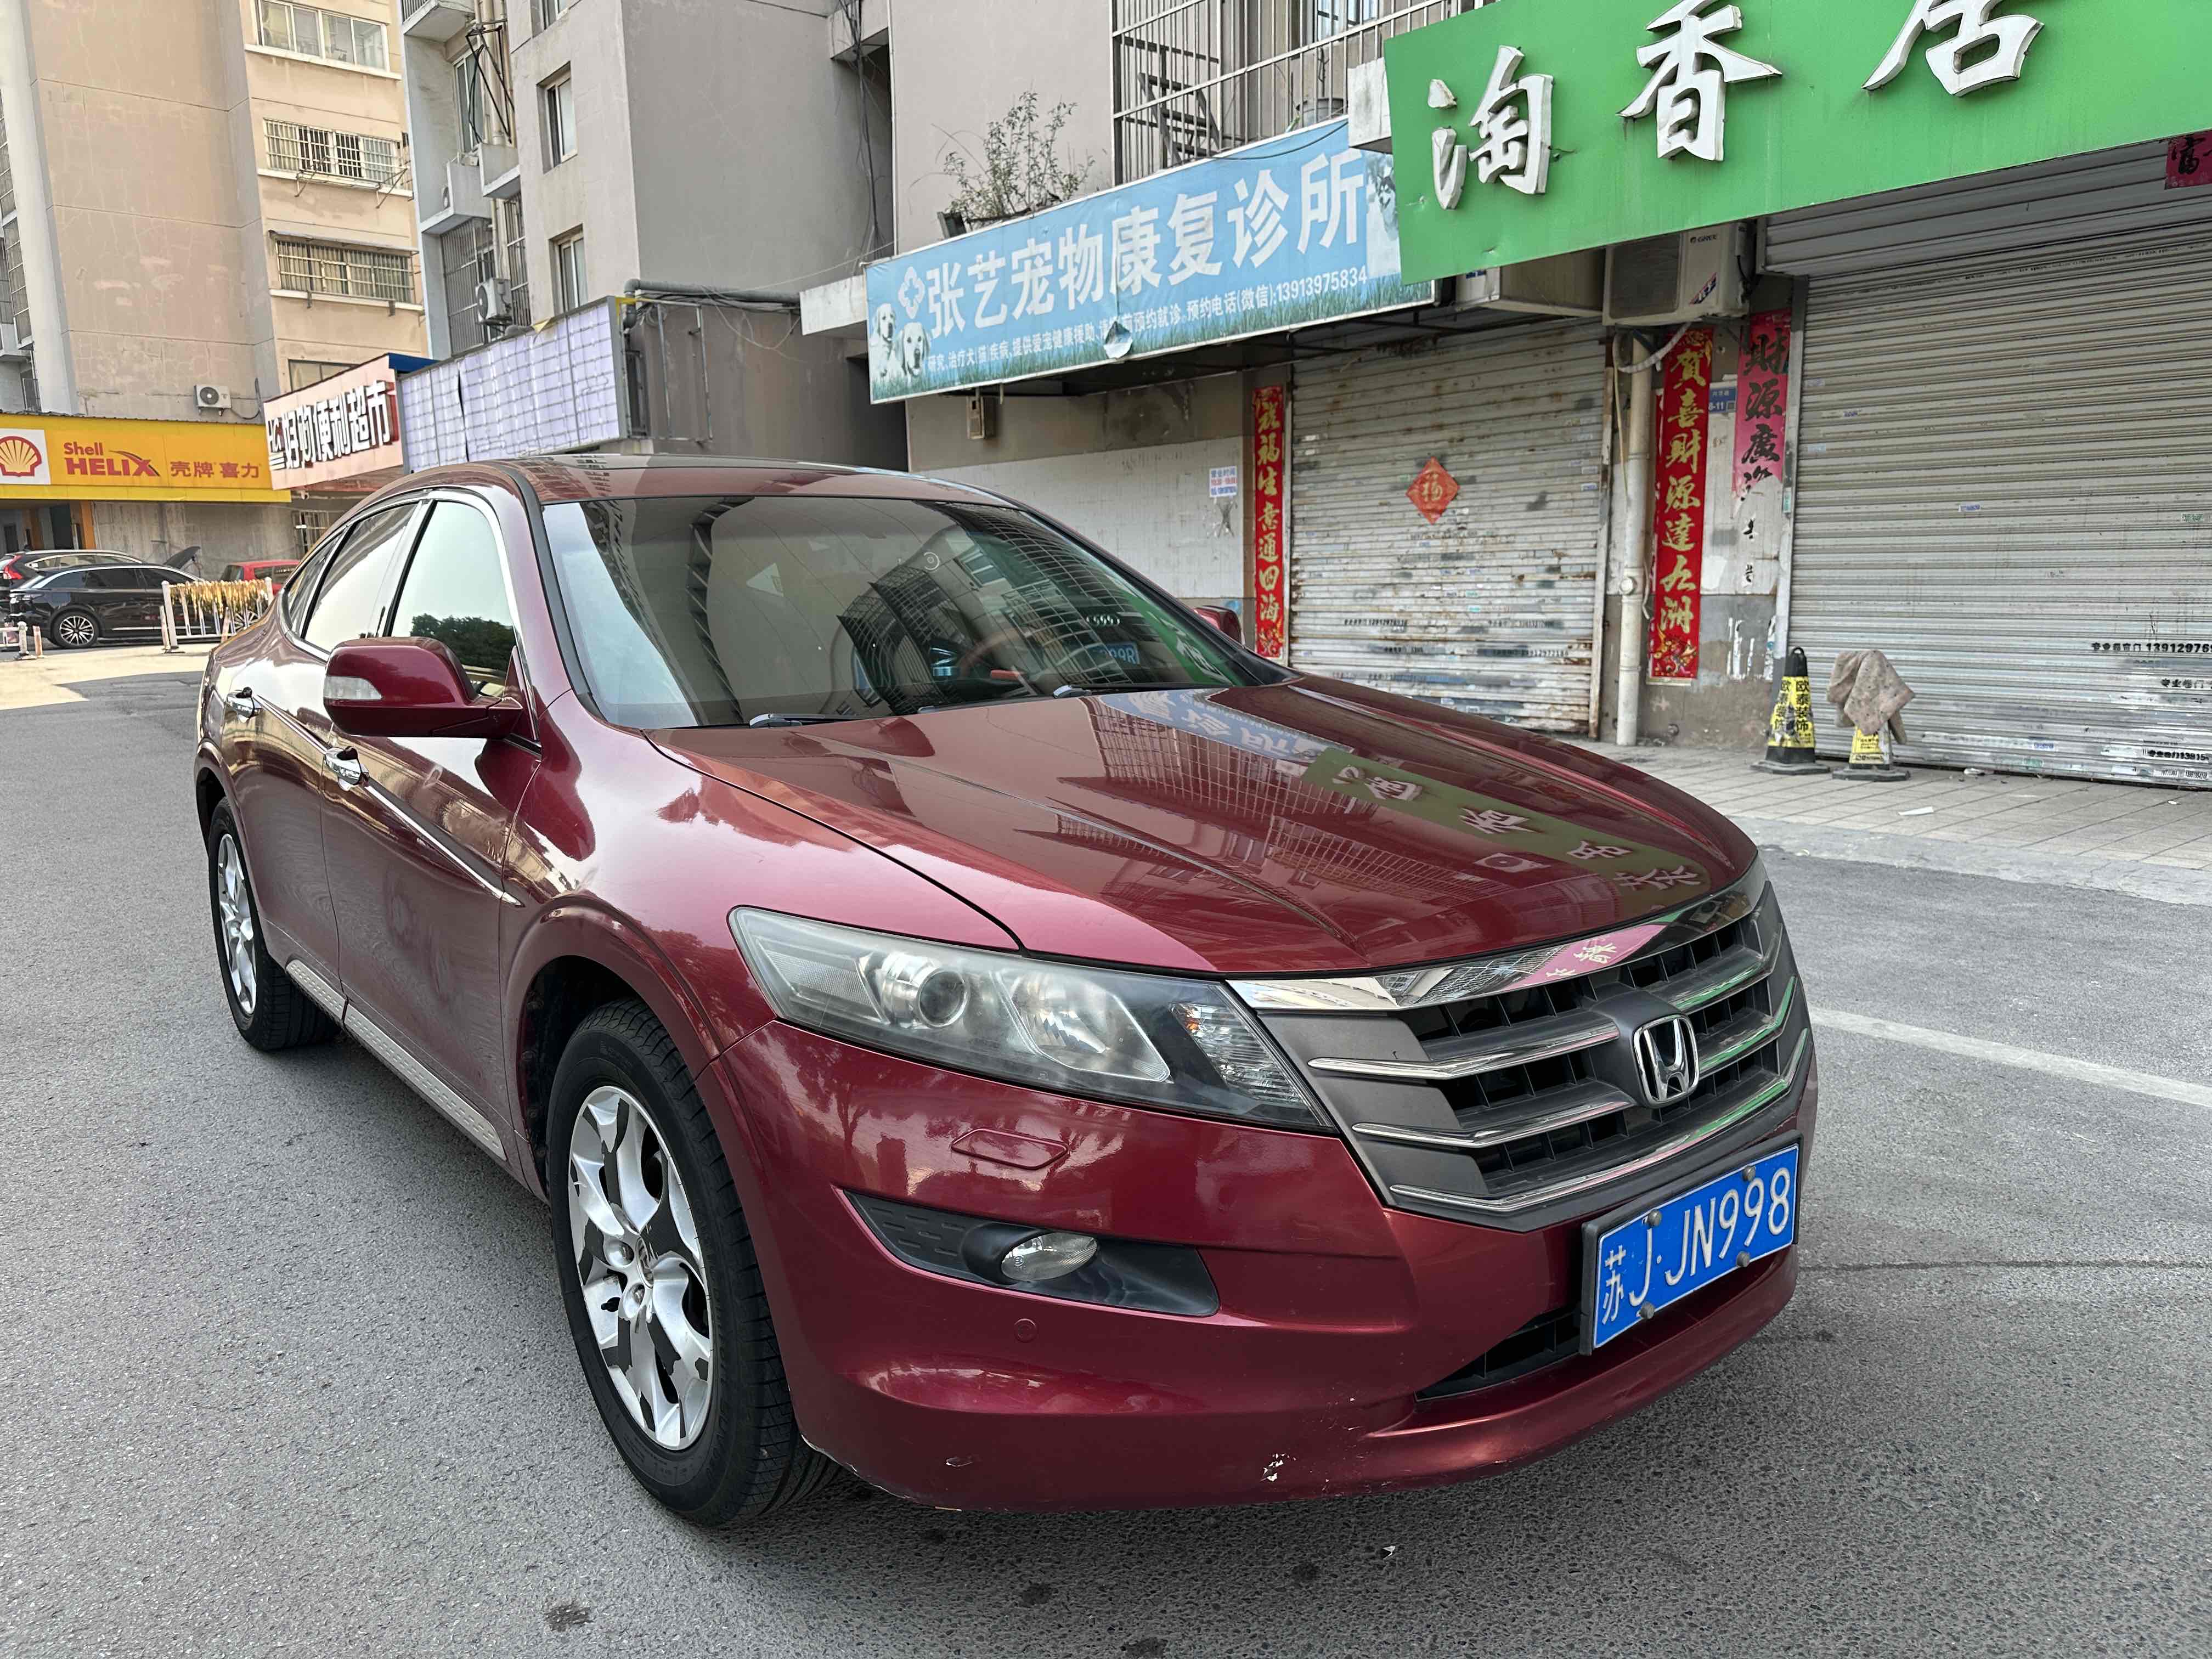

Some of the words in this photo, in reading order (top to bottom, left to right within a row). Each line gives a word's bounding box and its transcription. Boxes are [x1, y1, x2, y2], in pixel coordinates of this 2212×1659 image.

[926, 150, 1364, 338] 张艺宠物康复诊所
[64, 442, 103, 456] Shell
[65, 458, 160, 477] HELIX
[170, 461, 215, 478] 壳牌
[220, 462, 260, 479] 喜力
[2146, 642, 2212, 653] 13912976
